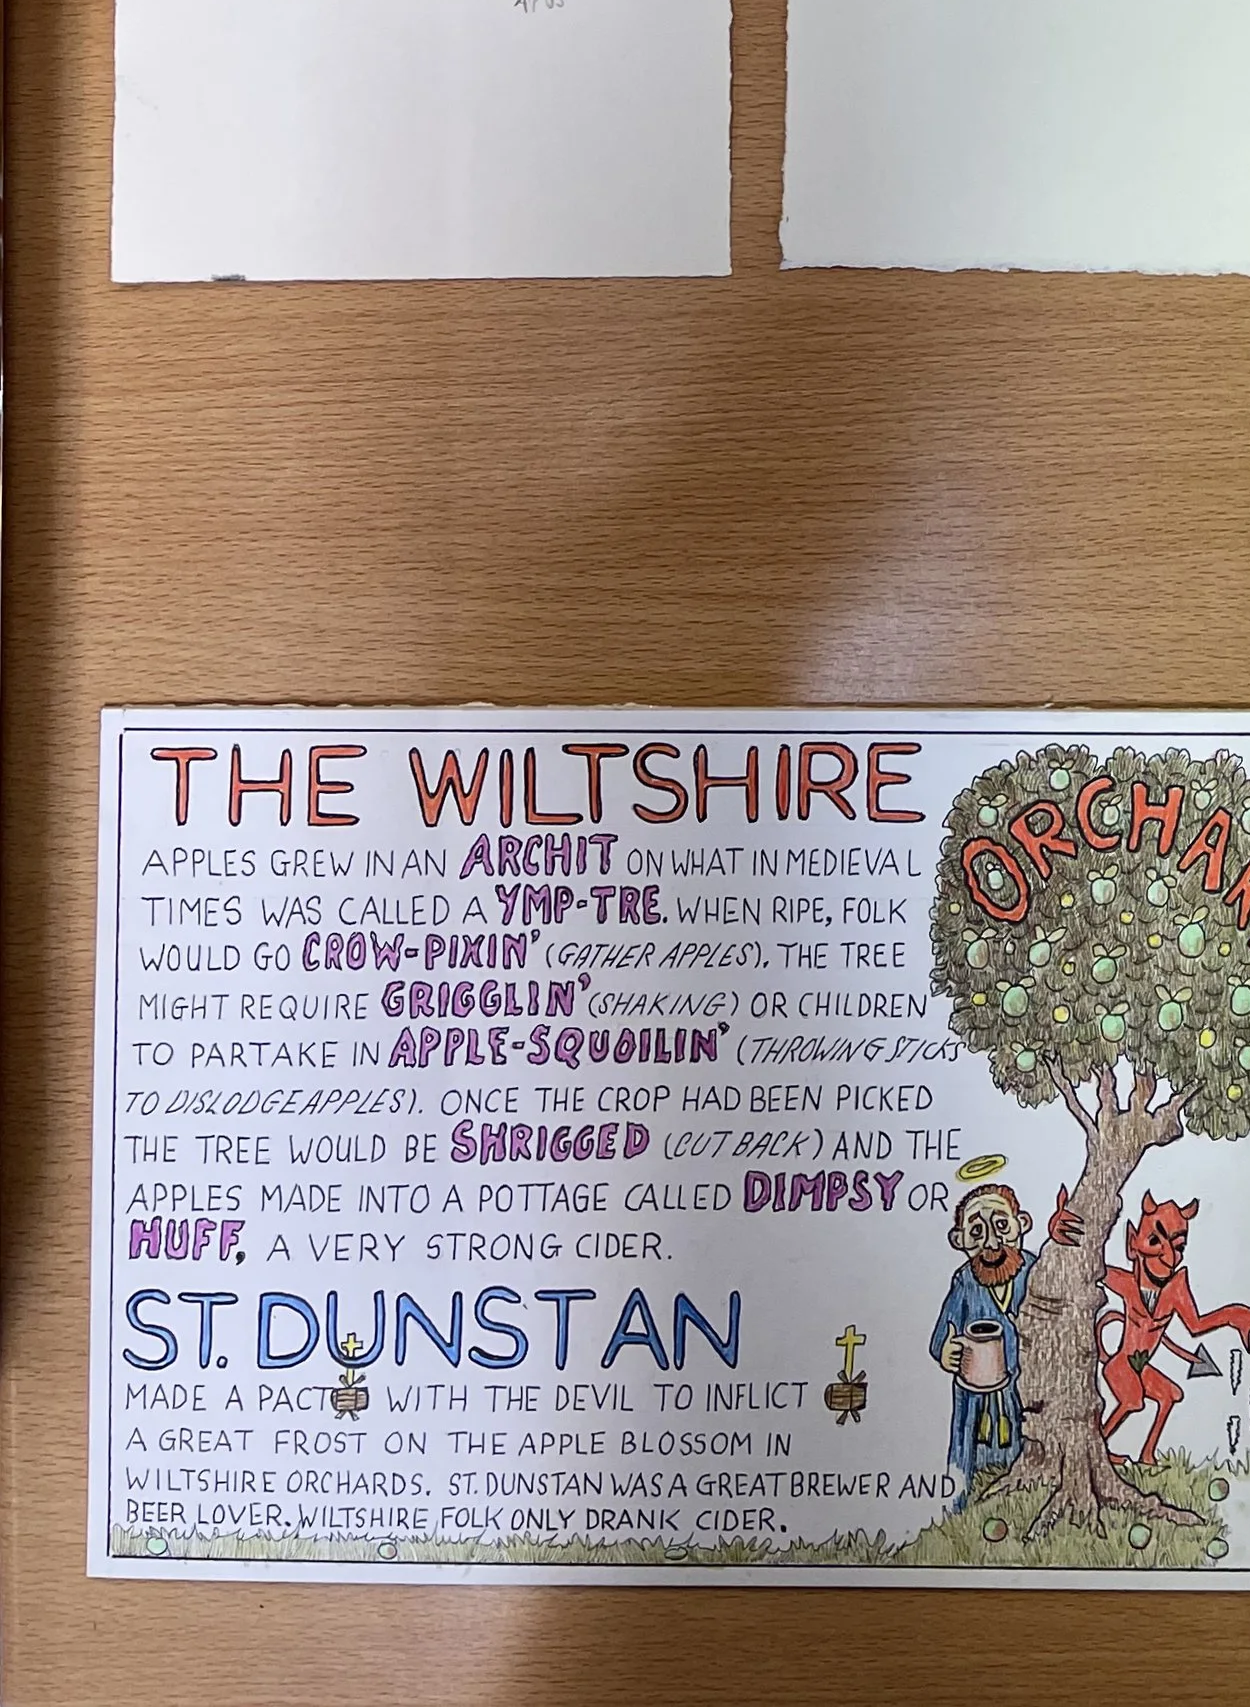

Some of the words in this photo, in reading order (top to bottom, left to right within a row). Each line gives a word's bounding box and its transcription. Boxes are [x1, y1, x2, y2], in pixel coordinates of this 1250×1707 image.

[150, 741, 367, 829] THE
[409, 741, 925, 829] WILTSHIRE
[140, 894, 242, 928] TIMES
[261, 894, 322, 928] WAS
[337, 894, 451, 928] CALLED
[460, 894, 489, 926] A
[676, 894, 761, 927] WHEN
[772, 894, 834, 929] RIPE,
[842, 895, 908, 926] FOLK
[139, 942, 242, 973] WOULD
[253, 942, 292, 973] GO
[776, 941, 830, 970] THE
[844, 941, 905, 970] TREE
[138, 993, 229, 1022] MIGHT
[240, 993, 368, 1023] REQUIRE
[586, 990, 740, 1022] (SHAKING)
[749, 992, 790, 1021] OR
[797, 989, 928, 1021] CHILDREN
[133, 1041, 174, 1068] TO
[190, 1039, 339, 1070] PARTAKE
[351, 1039, 381, 1069] IN
[124, 1134, 178, 1166] THE
[194, 1134, 271, 1166] TREE
[288, 1134, 387, 1166] WOULD
[403, 1134, 439, 1164] BE
[449, 1118, 651, 1166] SHRIGGED
[831, 1129, 894, 1162] AND
[904, 1128, 962, 1162] THE
[125, 1183, 242, 1215] APPLES
[260, 1183, 342, 1215] MADE
[357, 1183, 432, 1215] INTO
[440, 1183, 465, 1214] A
[478, 1181, 610, 1214] POTTAGE
[623, 1181, 732, 1213] CALLED
[742, 1169, 905, 1215] DIMPSY
[907, 1180, 950, 1214] OR
[266, 1232, 292, 1263] A
[308, 1231, 407, 1263] VERY
[425, 1231, 565, 1263] STRONG
[574, 1230, 674, 1262] CIDER.
[121, 1287, 239, 1372] ST.
[256, 1287, 744, 1372] DUNSTAN
[125, 1382, 207, 1413] MADE
[223, 1383, 245, 1413] A
[257, 1382, 335, 1413] PACT
[387, 1382, 469, 1414] WITH
[482, 1383, 537, 1414] THE
[554, 1382, 636, 1414] DEVIL
[654, 1382, 695, 1413] TO
[705, 1380, 808, 1413] INFLICT
[124, 1425, 149, 1453] A
[157, 1426, 254, 1454] GREAT
[273, 1428, 369, 1457] FROST
[383, 1429, 428, 1456] ON
[446, 1429, 509, 1457] THE
[517, 1429, 608, 1458] APPLE
[619, 1429, 753, 1458] BLOSSOM
[765, 1431, 793, 1458] IN
[125, 1498, 188, 1527] BEER
[297, 1502, 430, 1531] WILTSHIRE
[440, 1504, 505, 1532] FOLK
[510, 1506, 576, 1534] ONLY
[584, 1506, 682, 1533] DRANK
[695, 1505, 789, 1535] CIDER.
